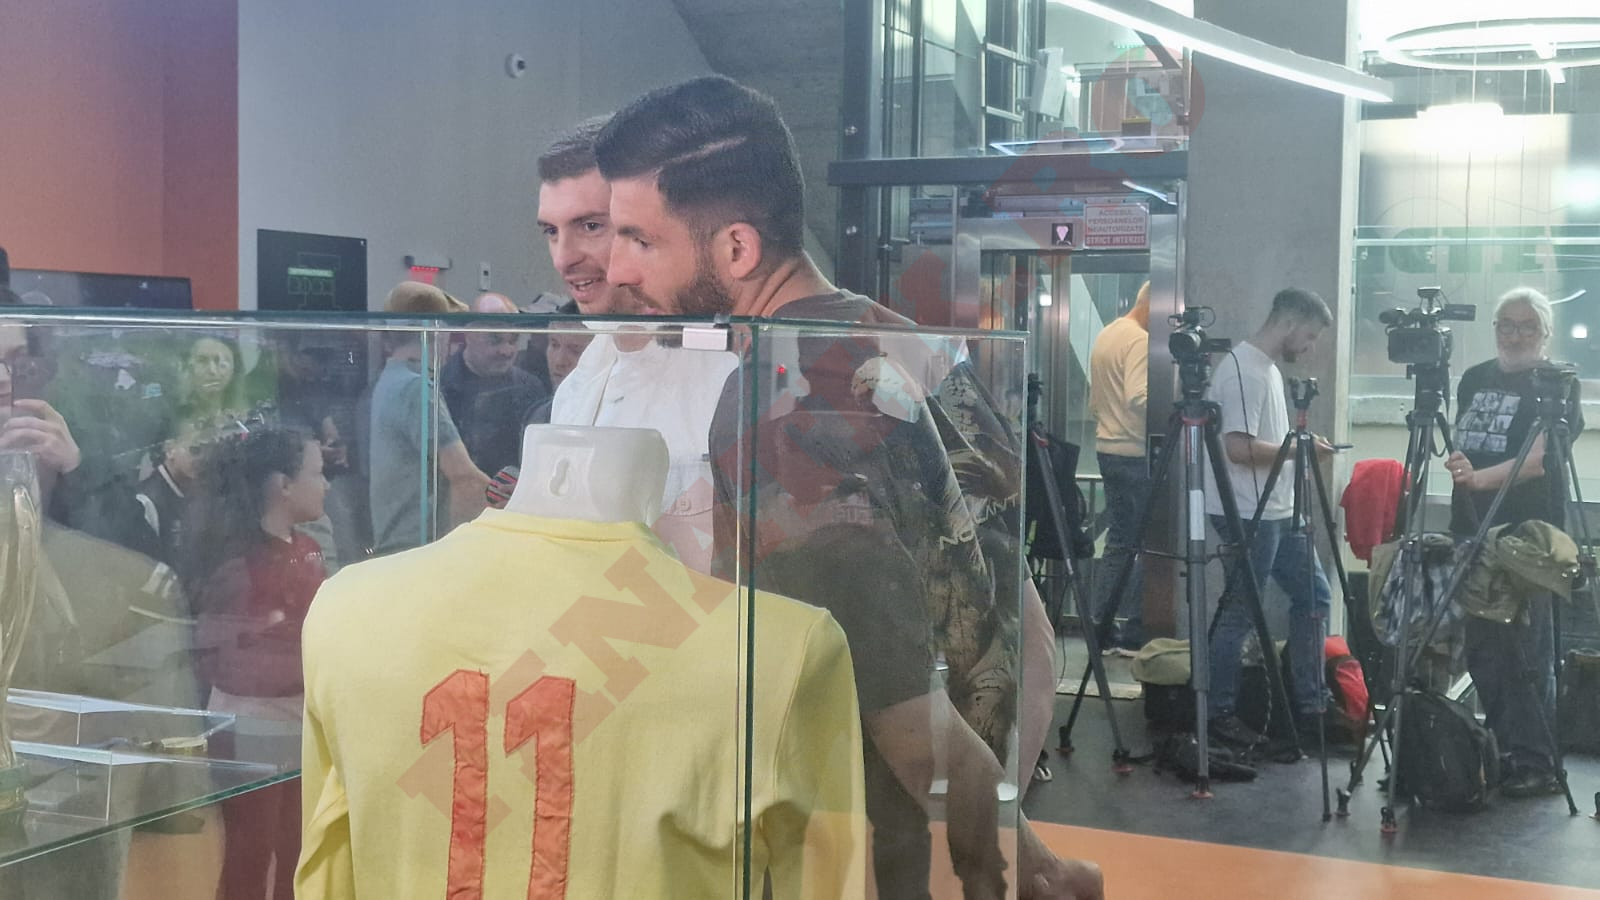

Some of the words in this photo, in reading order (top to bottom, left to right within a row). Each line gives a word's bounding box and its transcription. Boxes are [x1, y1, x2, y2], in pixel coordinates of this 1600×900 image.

[1086, 236, 1111, 245] STRICT
[1112, 235, 1145, 244] INTERZIS
[420, 668, 576, 900] 11
